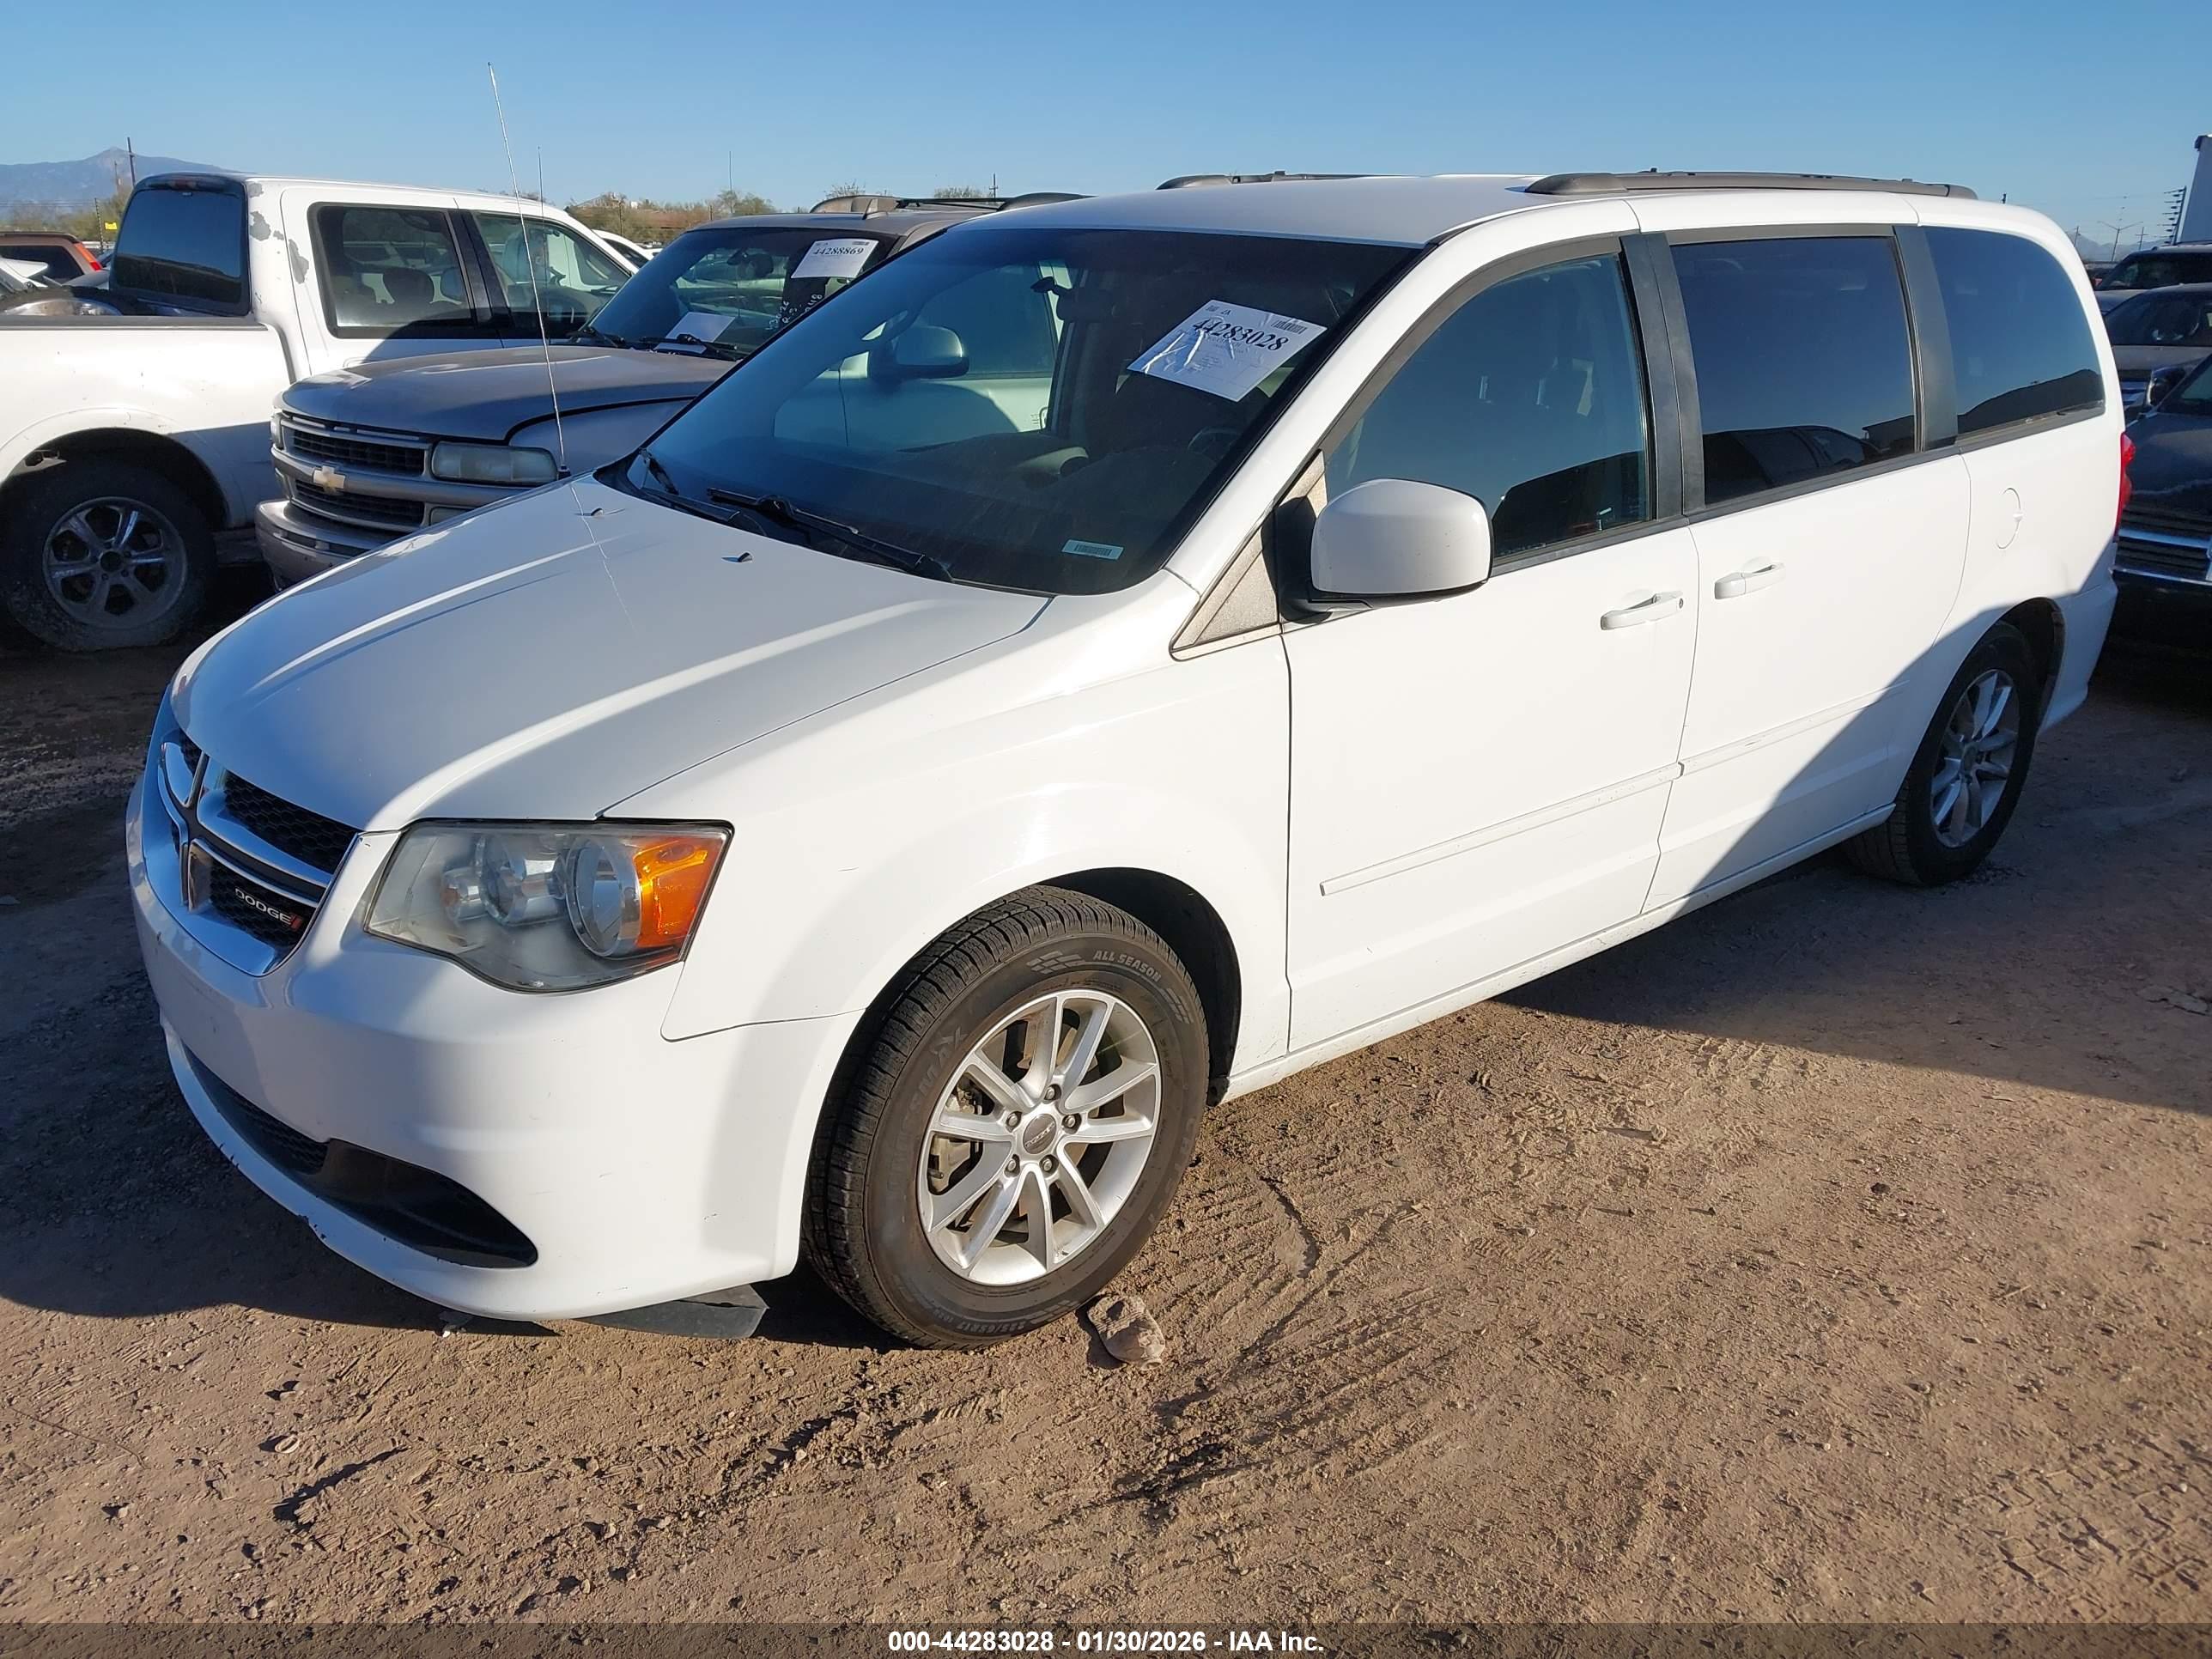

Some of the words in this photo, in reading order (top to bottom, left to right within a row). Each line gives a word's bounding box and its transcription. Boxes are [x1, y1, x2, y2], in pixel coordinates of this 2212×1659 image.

[812, 246, 864, 255] 44288869
[1192, 318, 1289, 351] 44283028
[234, 887, 292, 926] DODGE
[1092, 950, 1115, 962] ALL
[1116, 953, 1162, 982] SEASON
